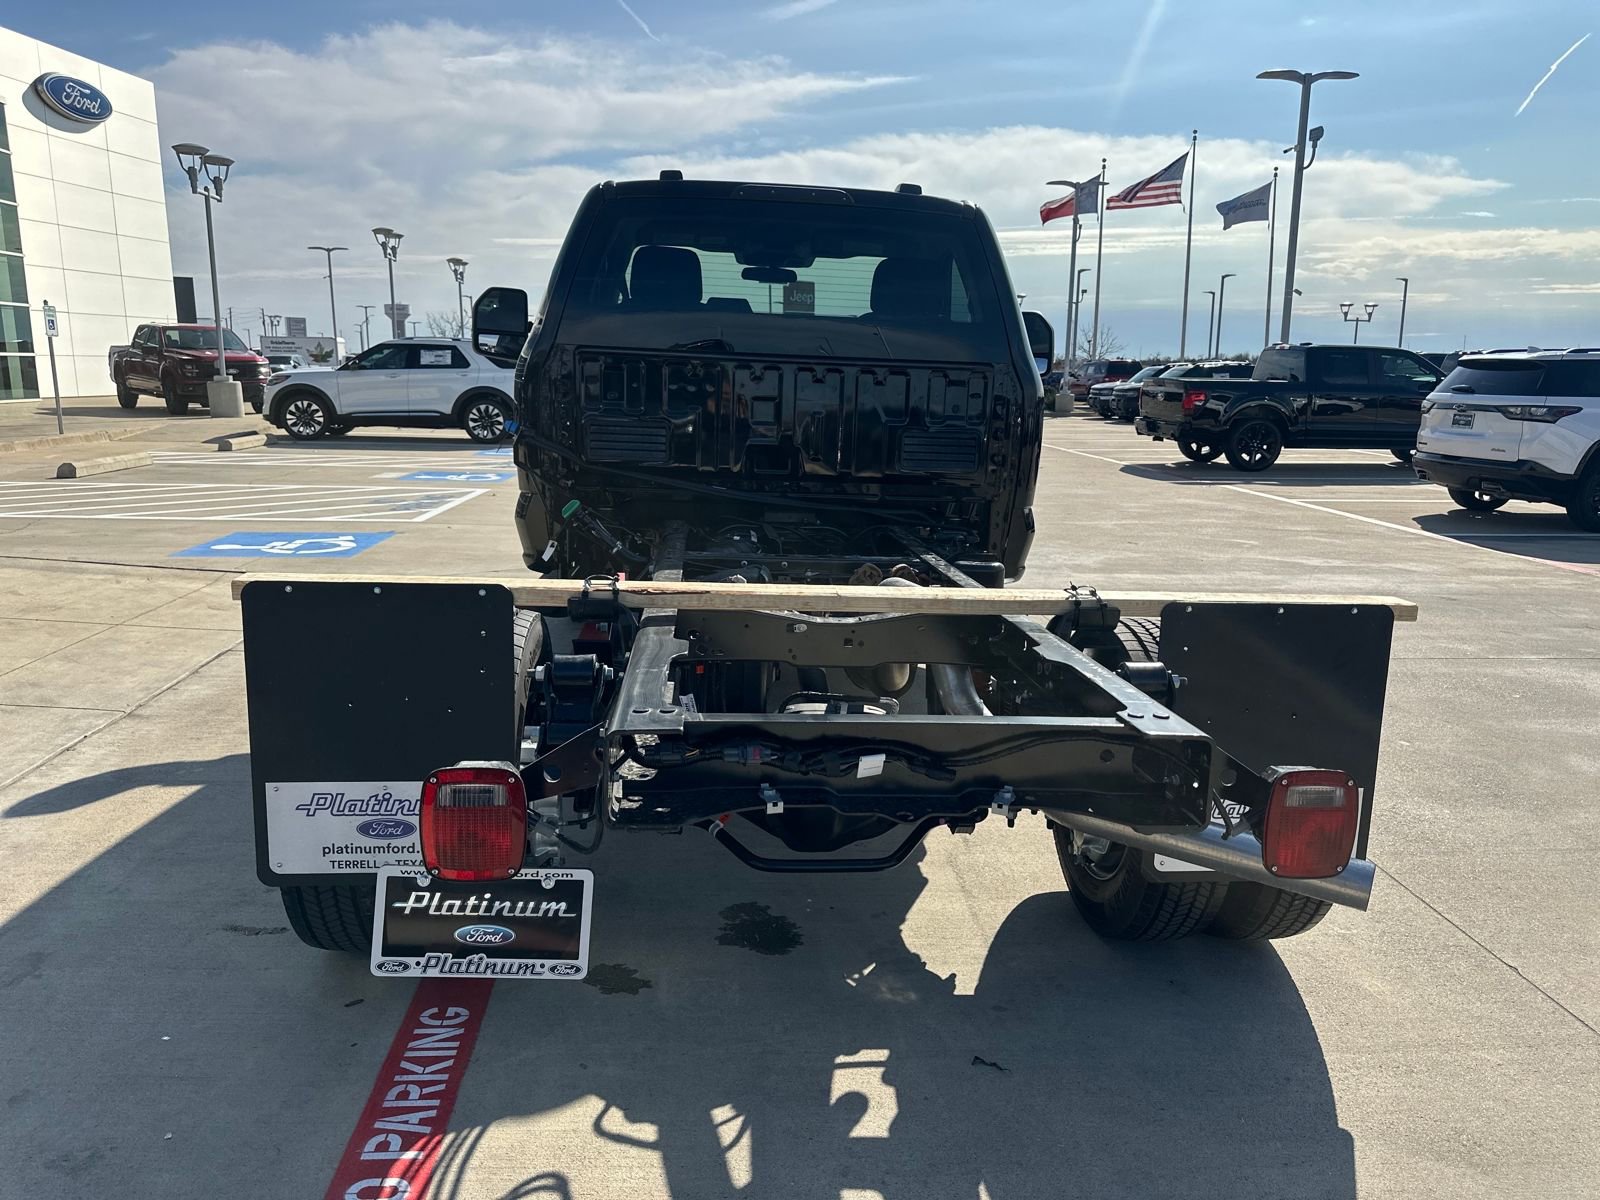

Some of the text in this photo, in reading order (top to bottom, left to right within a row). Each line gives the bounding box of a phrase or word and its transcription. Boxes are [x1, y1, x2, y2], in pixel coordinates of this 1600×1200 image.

[789, 290, 814, 304] Jeep
[296, 792, 421, 817] Platin
[369, 820, 404, 835] Ford
[322, 843, 421, 857] platinumford.
[329, 860, 380, 869] TERRELL
[514, 870, 574, 879] ord.com
[392, 892, 577, 917] Platinum
[466, 925, 504, 944] Ford
[413, 954, 546, 976] Platinum
[344, 1006, 470, 1200] O PARKING
